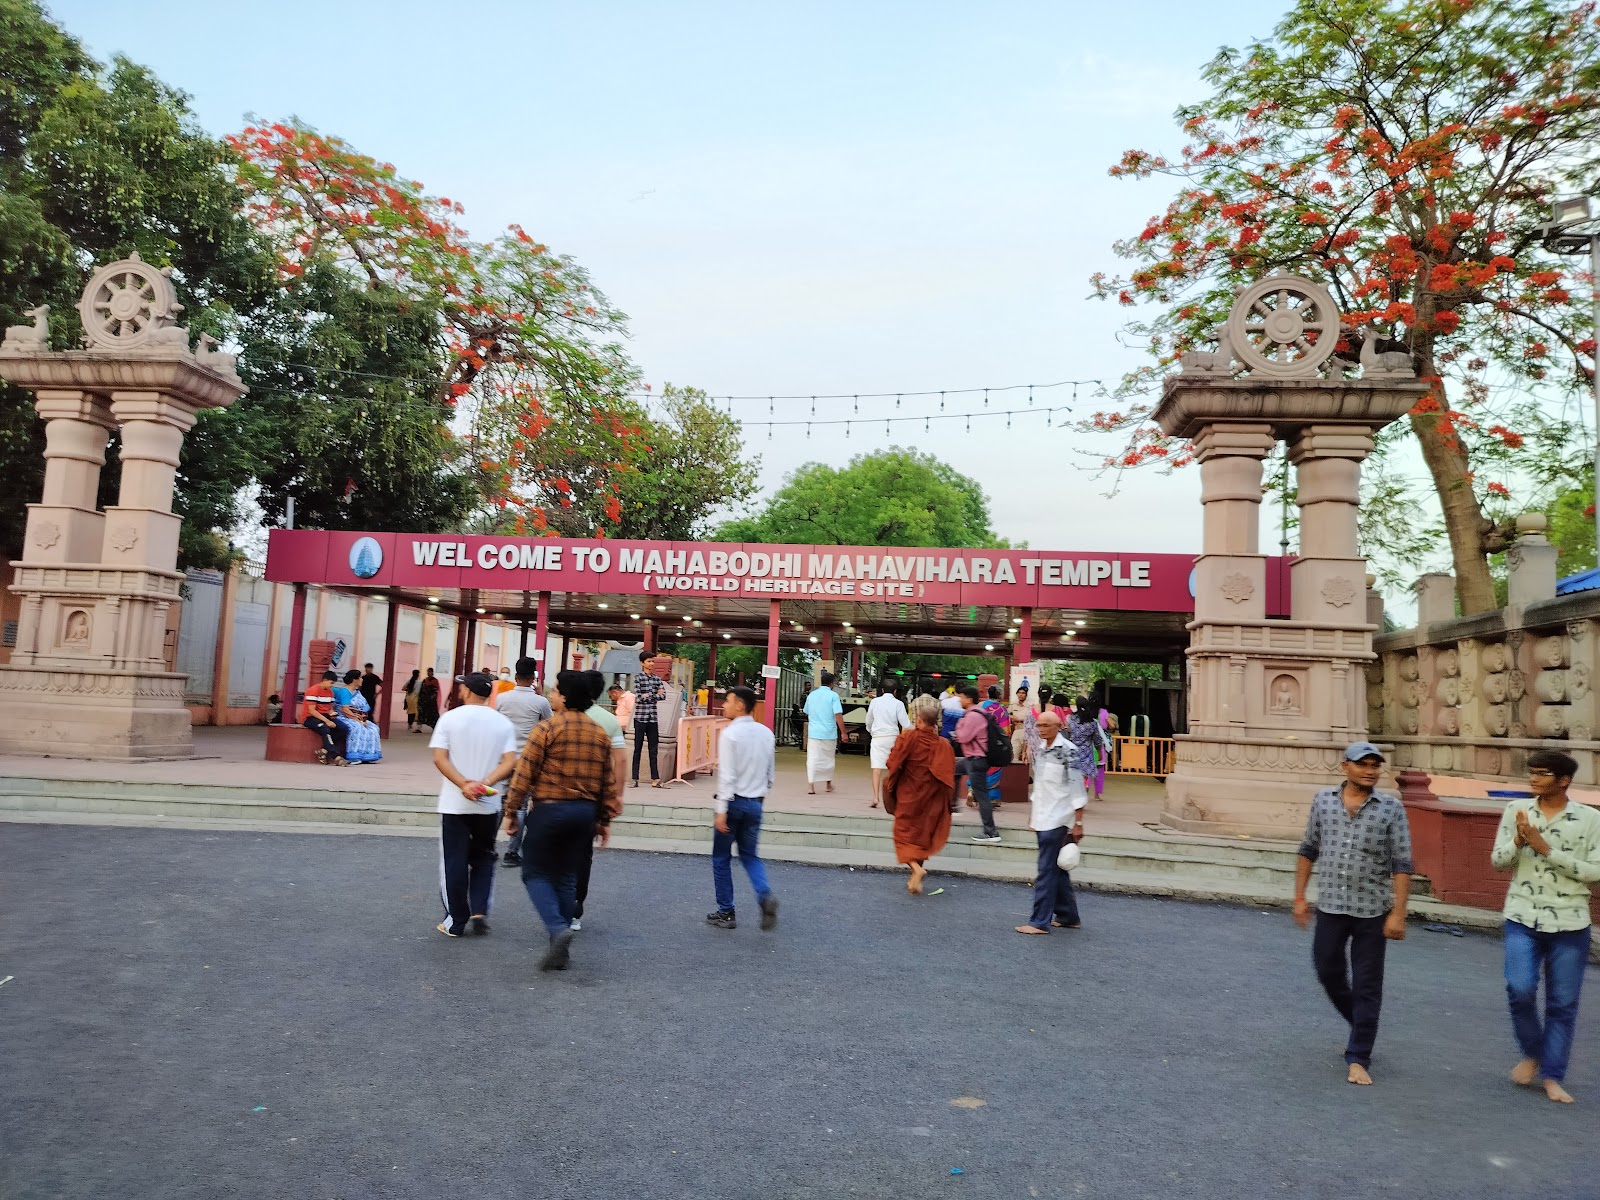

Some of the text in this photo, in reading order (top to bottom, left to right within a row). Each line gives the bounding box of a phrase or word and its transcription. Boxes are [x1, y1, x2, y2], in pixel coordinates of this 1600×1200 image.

[571, 547, 611, 573] TO
[620, 549, 801, 577] MAHABODHI
[809, 554, 1016, 584] MAHAVIHARA
[1020, 558, 1151, 587] TEMPLE
[744, 577, 855, 595] HERITAGE
